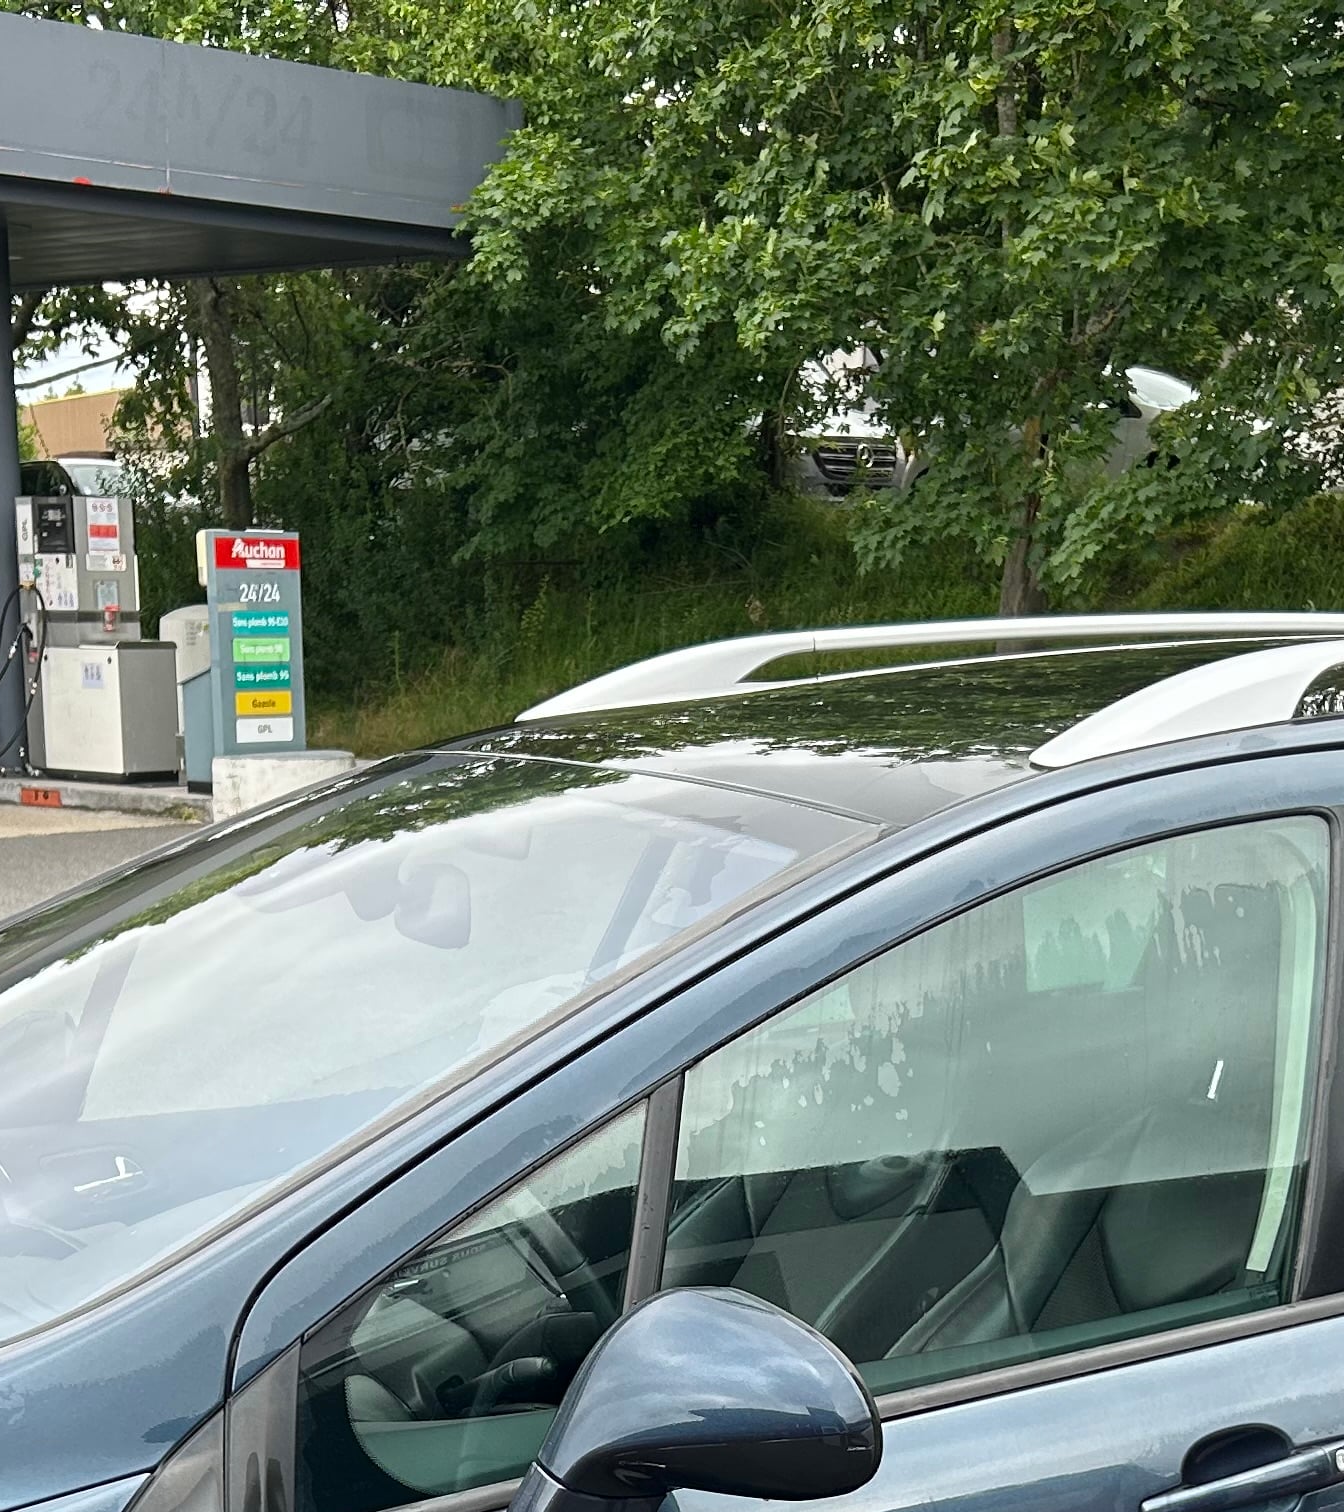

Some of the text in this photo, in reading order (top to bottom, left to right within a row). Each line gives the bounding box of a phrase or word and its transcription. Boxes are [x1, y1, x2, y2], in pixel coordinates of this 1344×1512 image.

[231, 538, 286, 559] Auchan
[232, 617, 247, 627] Sans
[236, 671, 255, 682] Sans
[256, 670, 278, 683] plomb
[252, 699, 276, 709] Gazole
[257, 724, 273, 734] GPL
